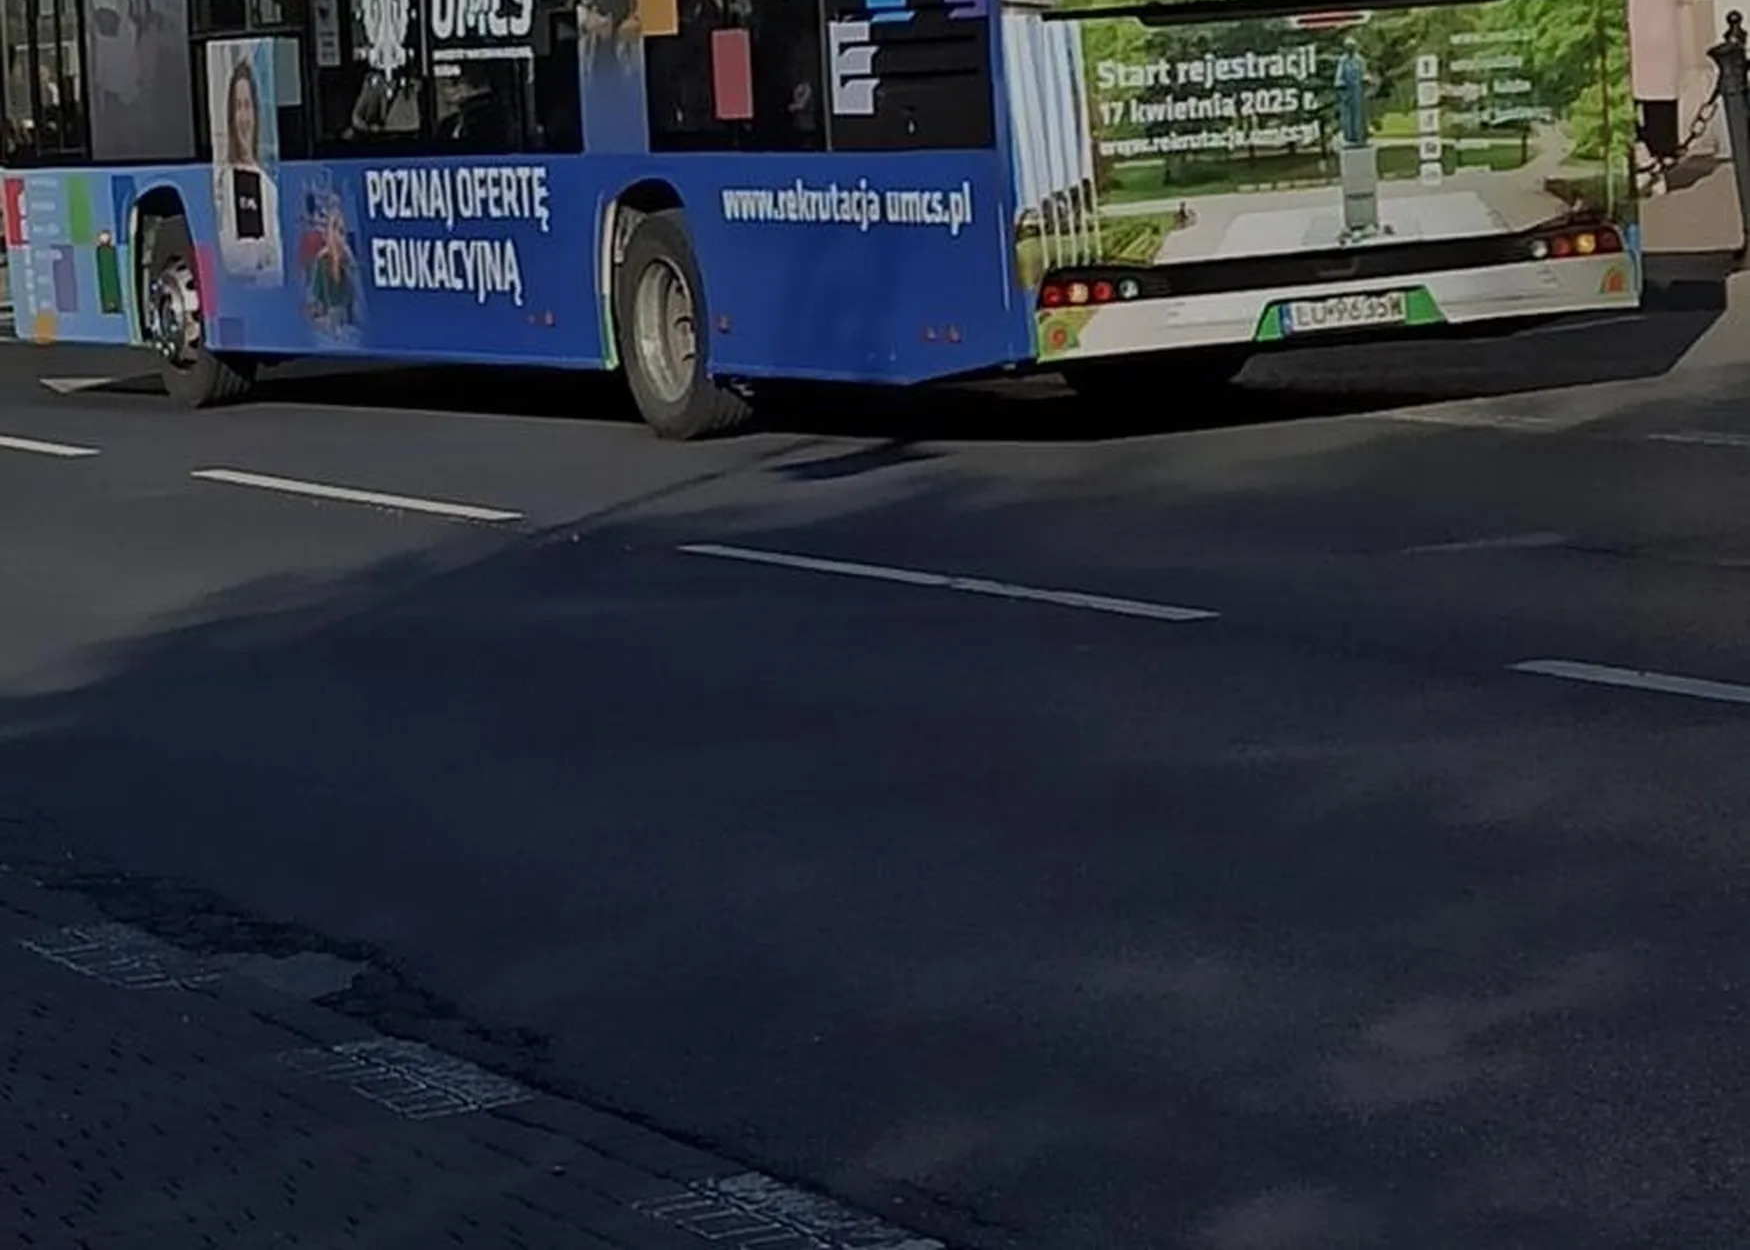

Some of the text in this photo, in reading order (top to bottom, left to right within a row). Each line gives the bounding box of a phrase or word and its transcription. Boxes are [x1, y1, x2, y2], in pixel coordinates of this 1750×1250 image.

[1097, 58, 1172, 89] Start
[1101, 101, 1125, 126] 17
[1130, 93, 1237, 124] kwietnia
[1240, 88, 1299, 117] 2025
[365, 166, 550, 232] POZNAJ OFERTĘ
[371, 236, 523, 306] EDUKACYJNĄ
